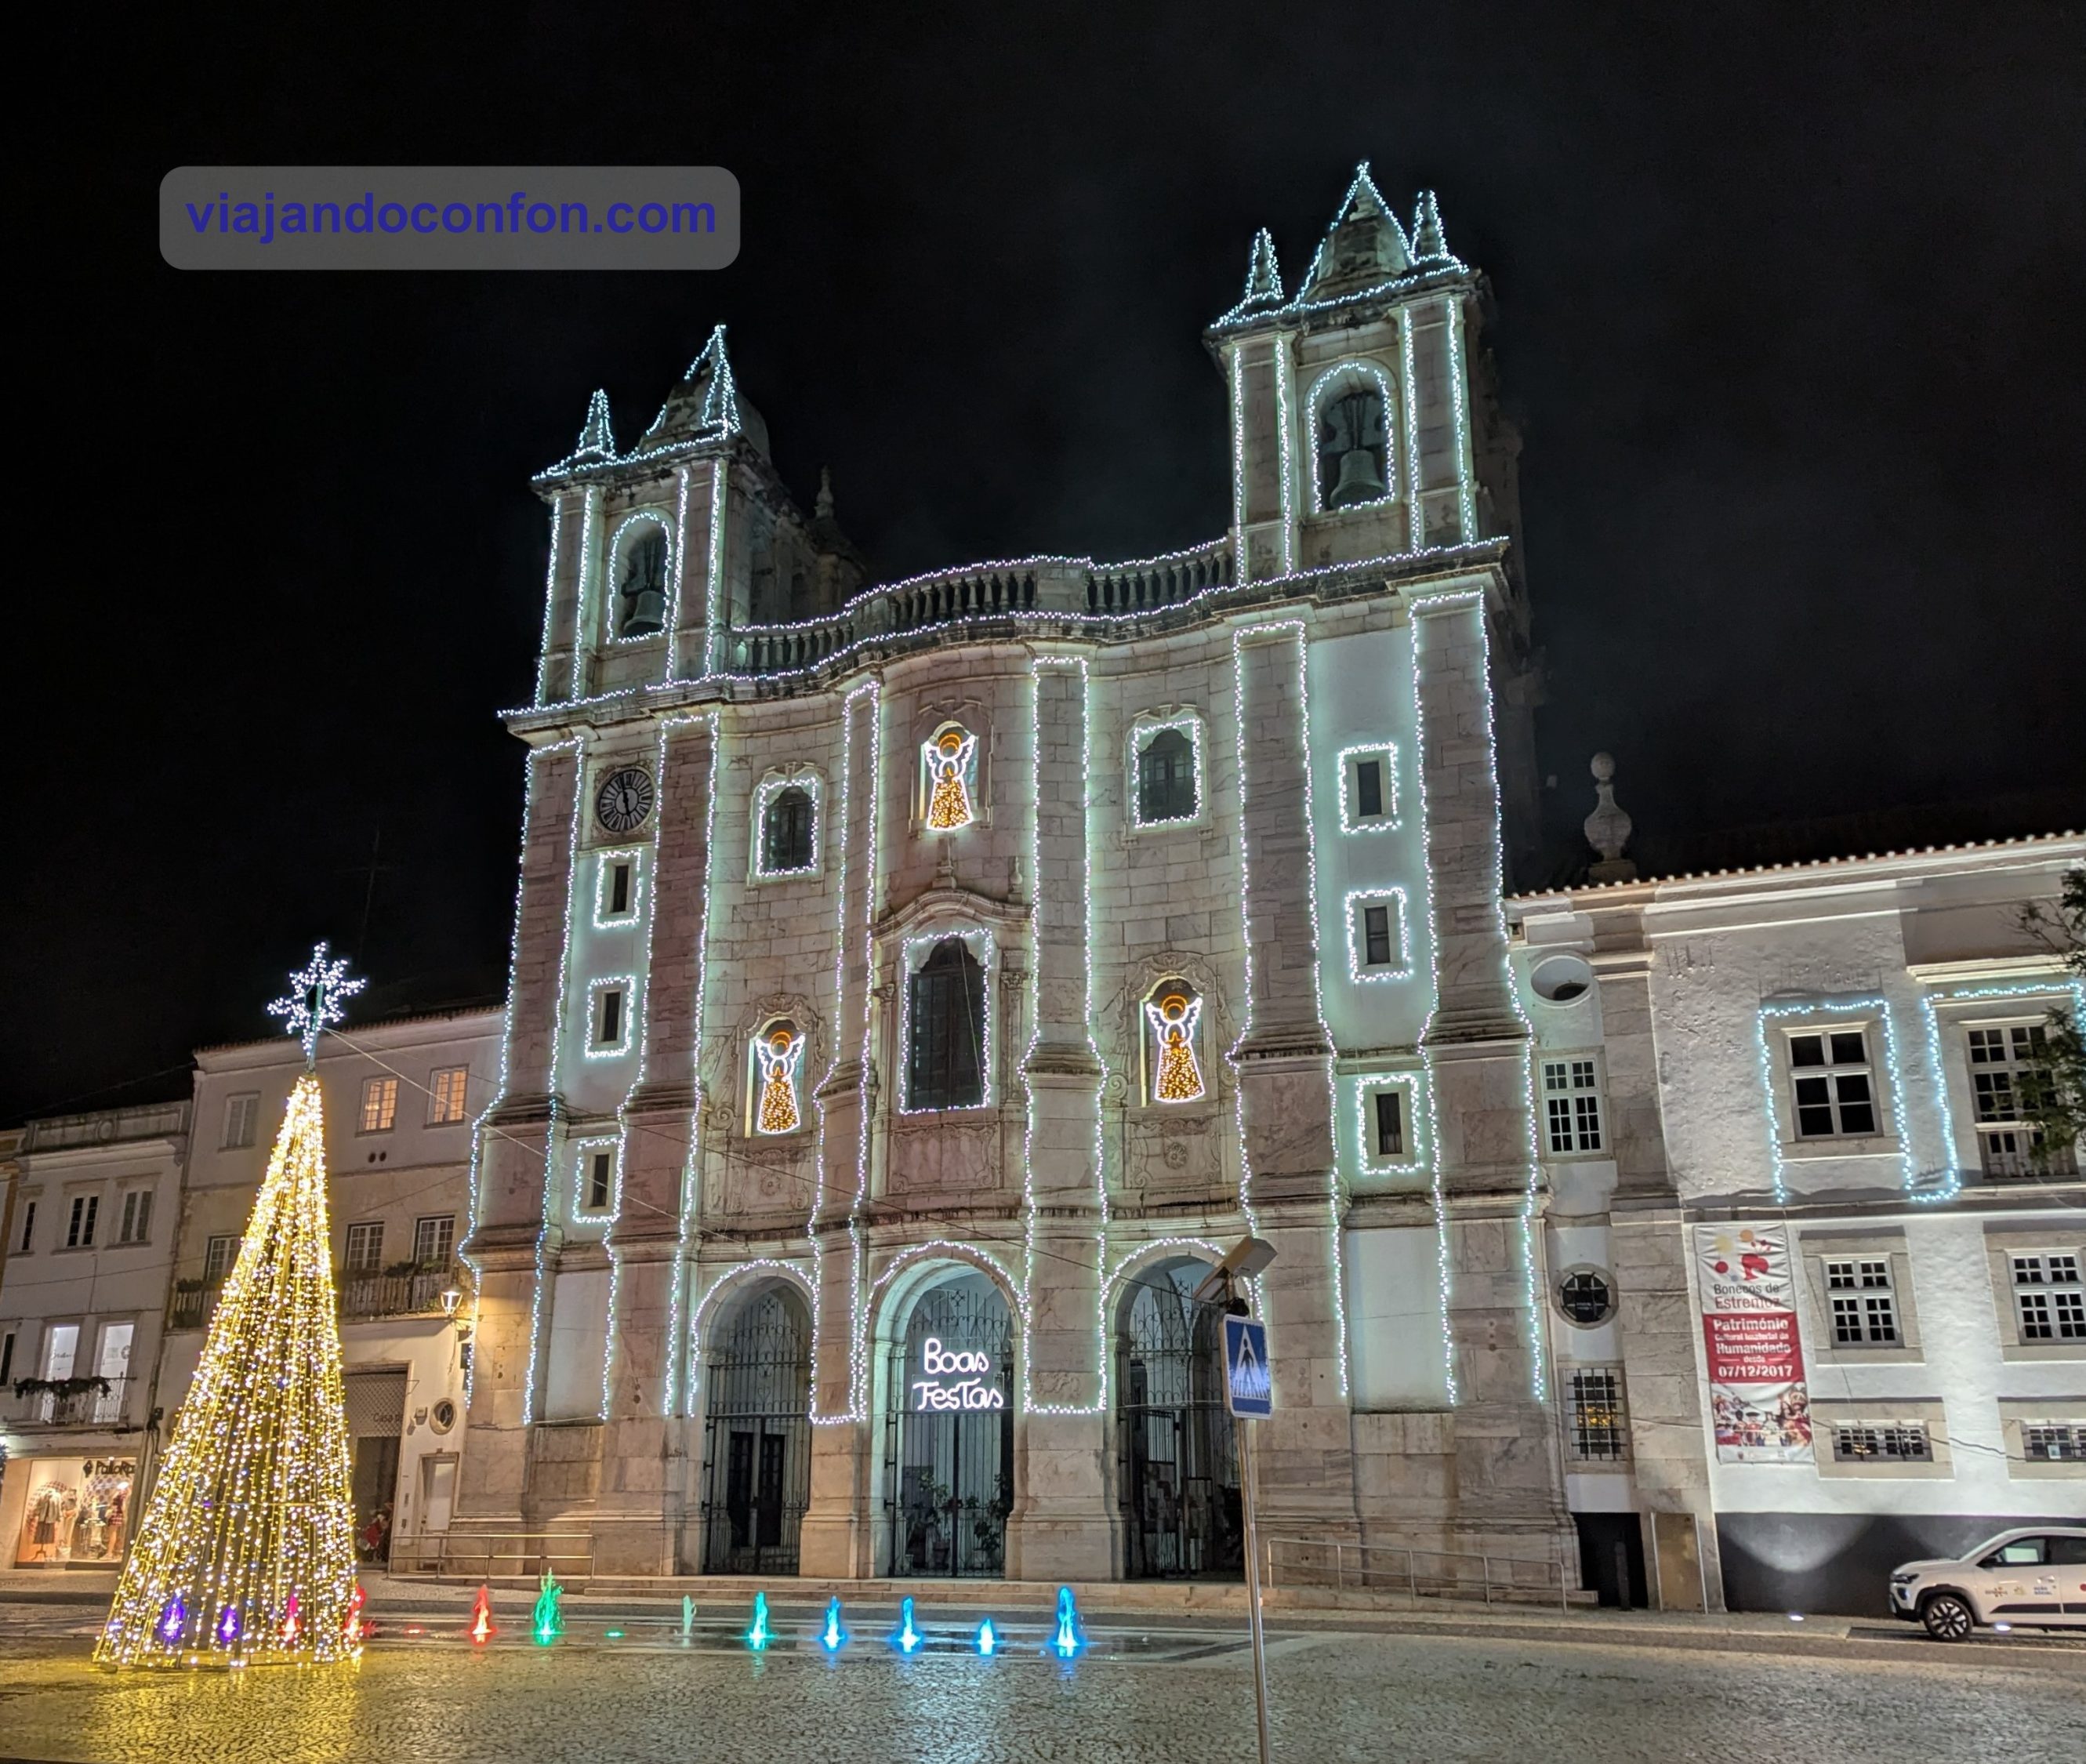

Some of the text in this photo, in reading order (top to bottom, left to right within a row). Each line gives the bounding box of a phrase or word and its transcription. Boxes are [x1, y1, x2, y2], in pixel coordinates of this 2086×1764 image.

[1714, 1283, 1779, 1295] Bonecos de
[1715, 1296, 1781, 1308] Estremoz
[1713, 1318, 1789, 1331] Património
[1716, 1342, 1792, 1355] Humanidade
[924, 1338, 989, 1374] Boas
[1718, 1365, 1793, 1377] 07/12/2017
